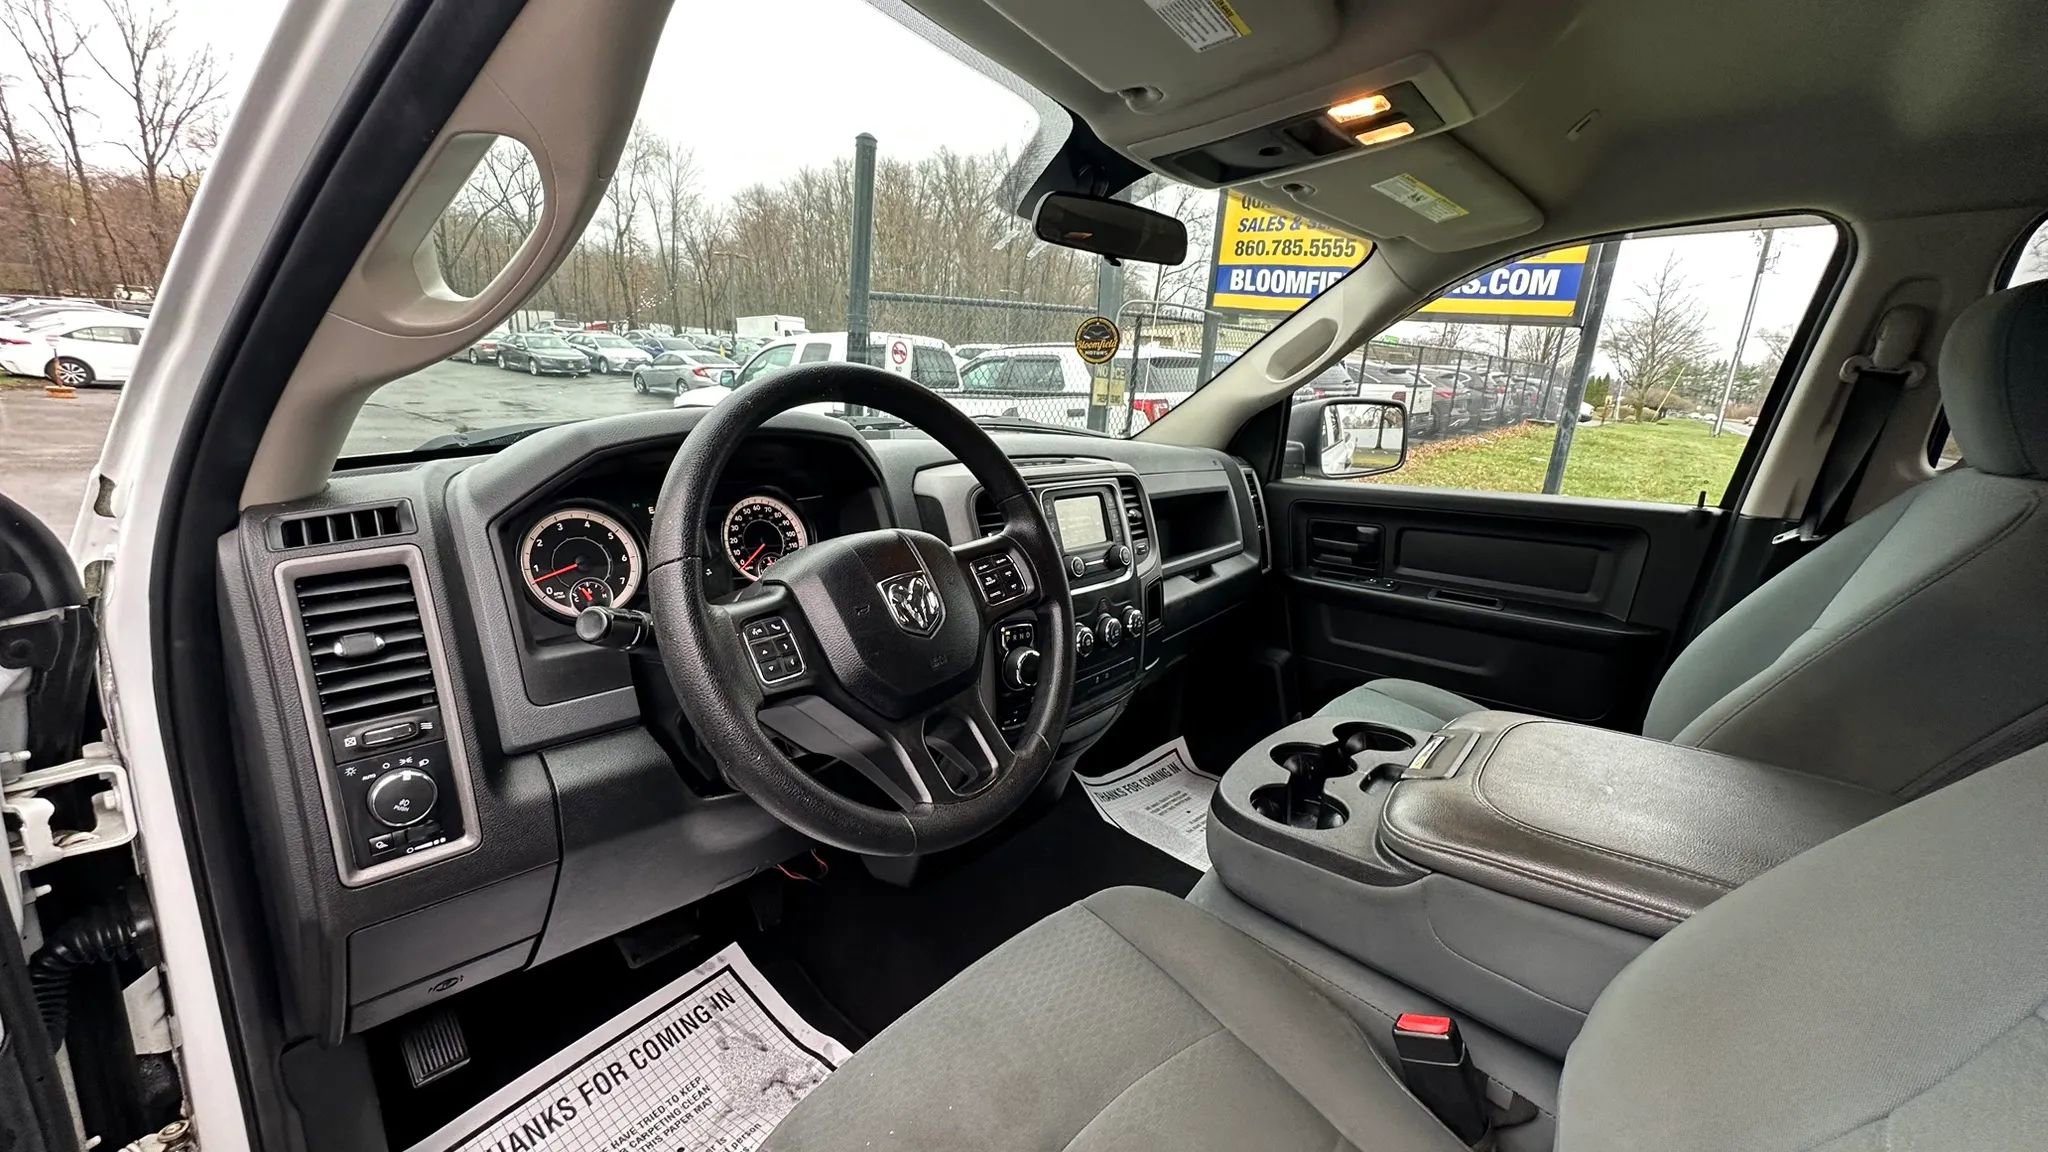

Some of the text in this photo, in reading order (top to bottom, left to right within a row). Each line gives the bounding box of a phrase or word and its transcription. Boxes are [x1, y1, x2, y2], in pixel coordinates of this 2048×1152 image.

[1237, 216, 1287, 232] SALES
[1289, 215, 1303, 231] &
[1234, 238, 1357, 258] 860.785.5555
[1076, 339, 1118, 351] Bloomfield
[556, 523, 564, 531] 3
[584, 520, 591, 528] 4
[607, 532, 614, 540] 5
[536, 539, 544, 547] 2
[621, 554, 628, 562] 6
[533, 564, 539, 572] 1
[619, 577, 626, 585] 7
[546, 586, 553, 595] 0
[1094, 787, 1128, 802] THANKS
[1122, 781, 1145, 794] FOR
[1139, 767, 1173, 787] COMING
[1167, 761, 1182, 774] IN
[577, 1062, 629, 1106] FOR
[628, 1004, 713, 1071] COMING
[710, 987, 736, 1012] IN
[610, 1076, 701, 1150] HAVE TRIED TO KEEP
[628, 1084, 712, 1149] CARPETING CLEAN
[639, 1097, 714, 1152] THIS PAPER MAT
[731, 1122, 762, 1150] person
